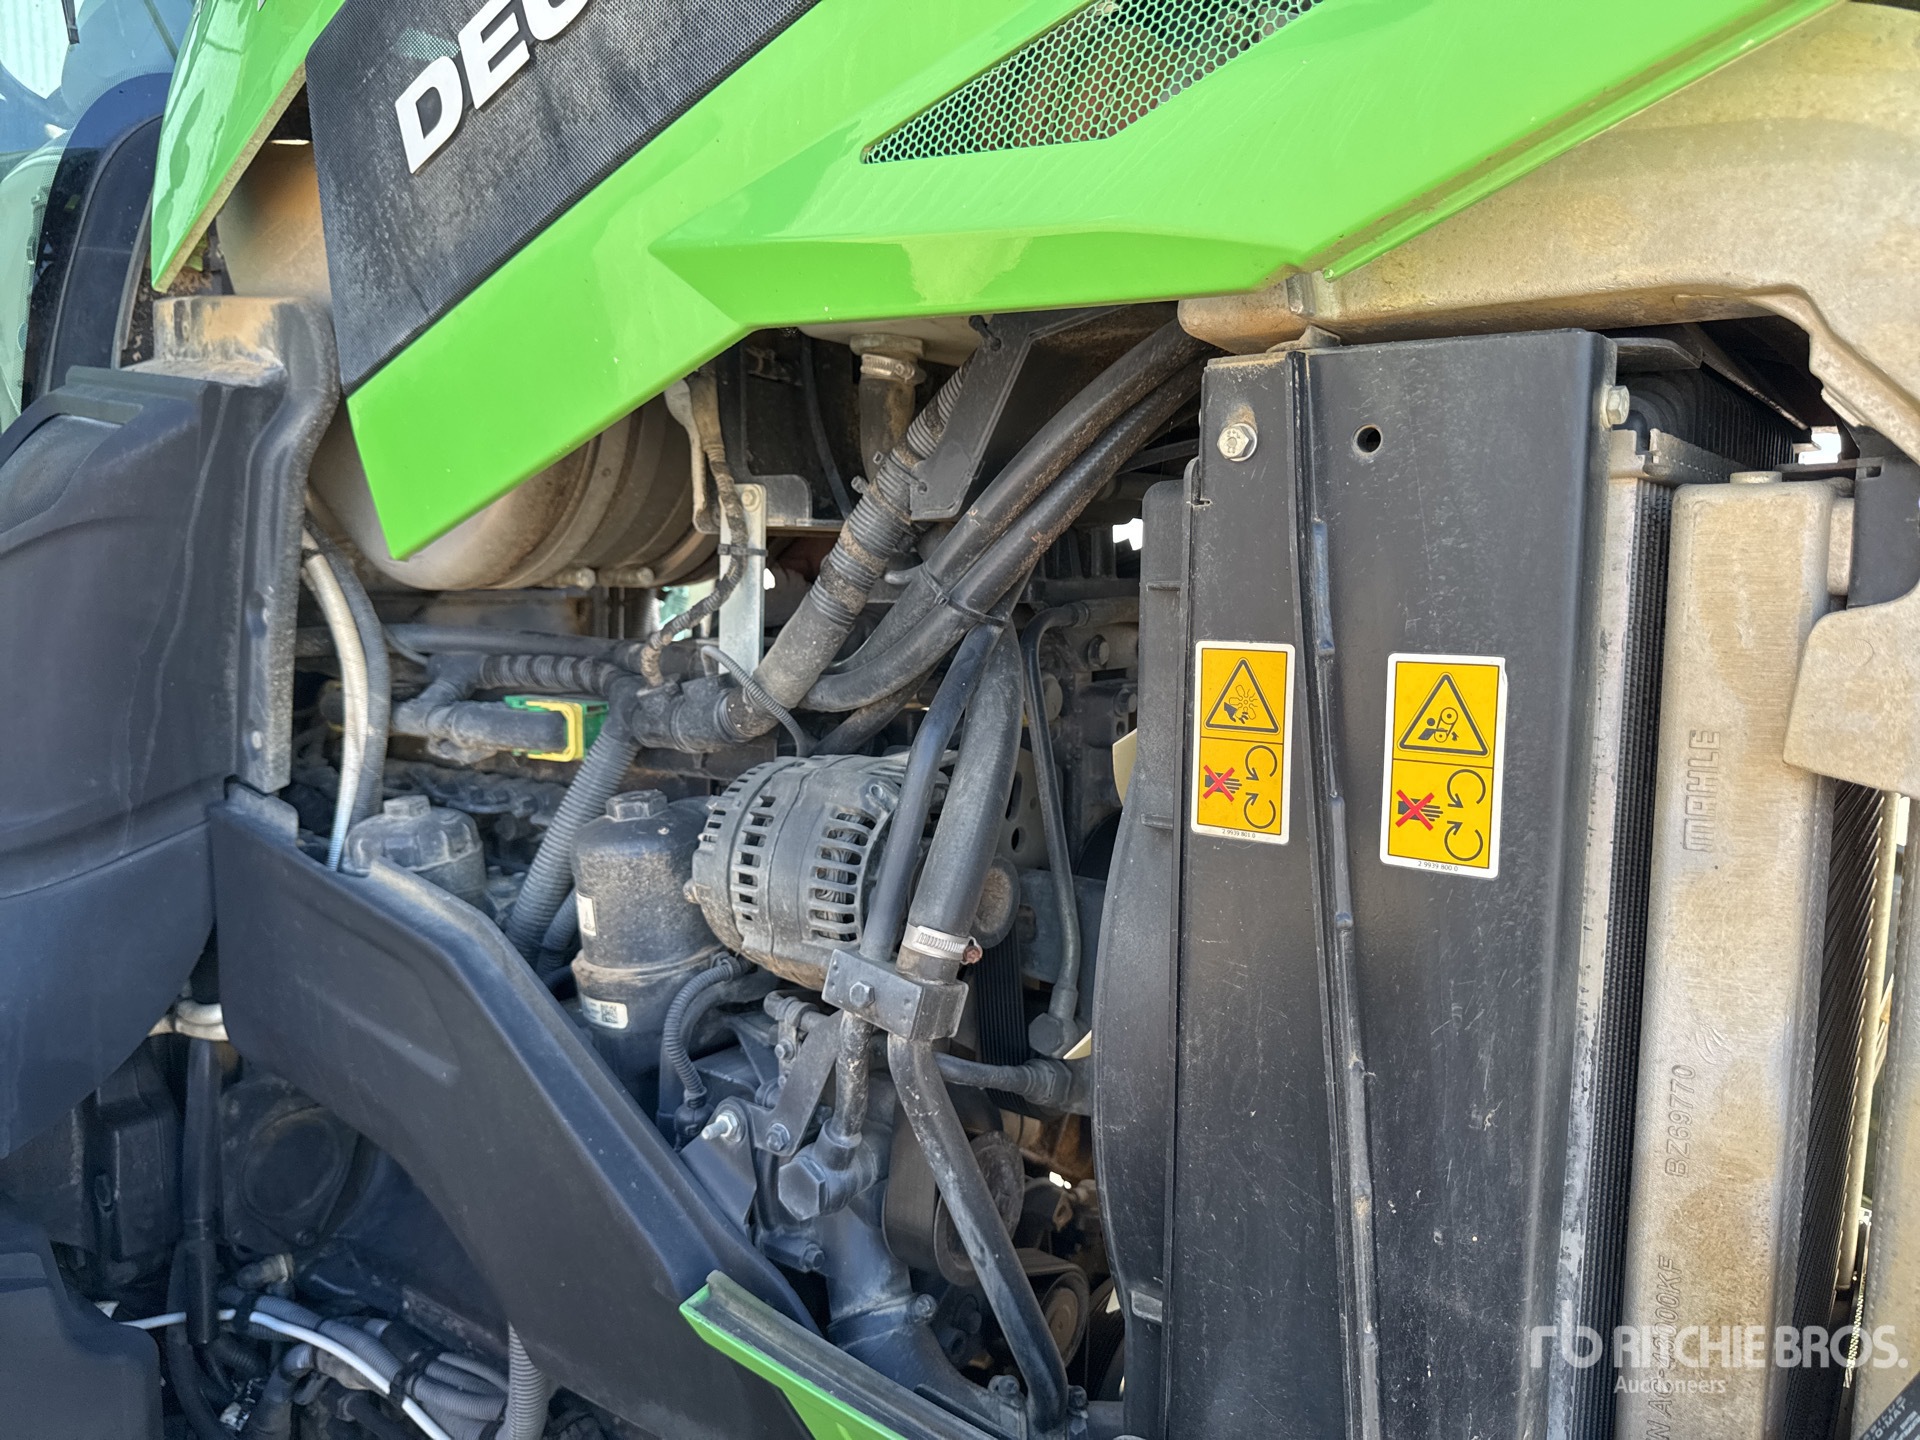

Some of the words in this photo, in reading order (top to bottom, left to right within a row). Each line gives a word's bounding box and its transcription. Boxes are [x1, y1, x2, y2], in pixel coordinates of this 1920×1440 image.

[1683, 729, 1721, 853] MAHLE
[1423, 861, 1439, 869] 9939
[1664, 1064, 1697, 1179] BZ69770
